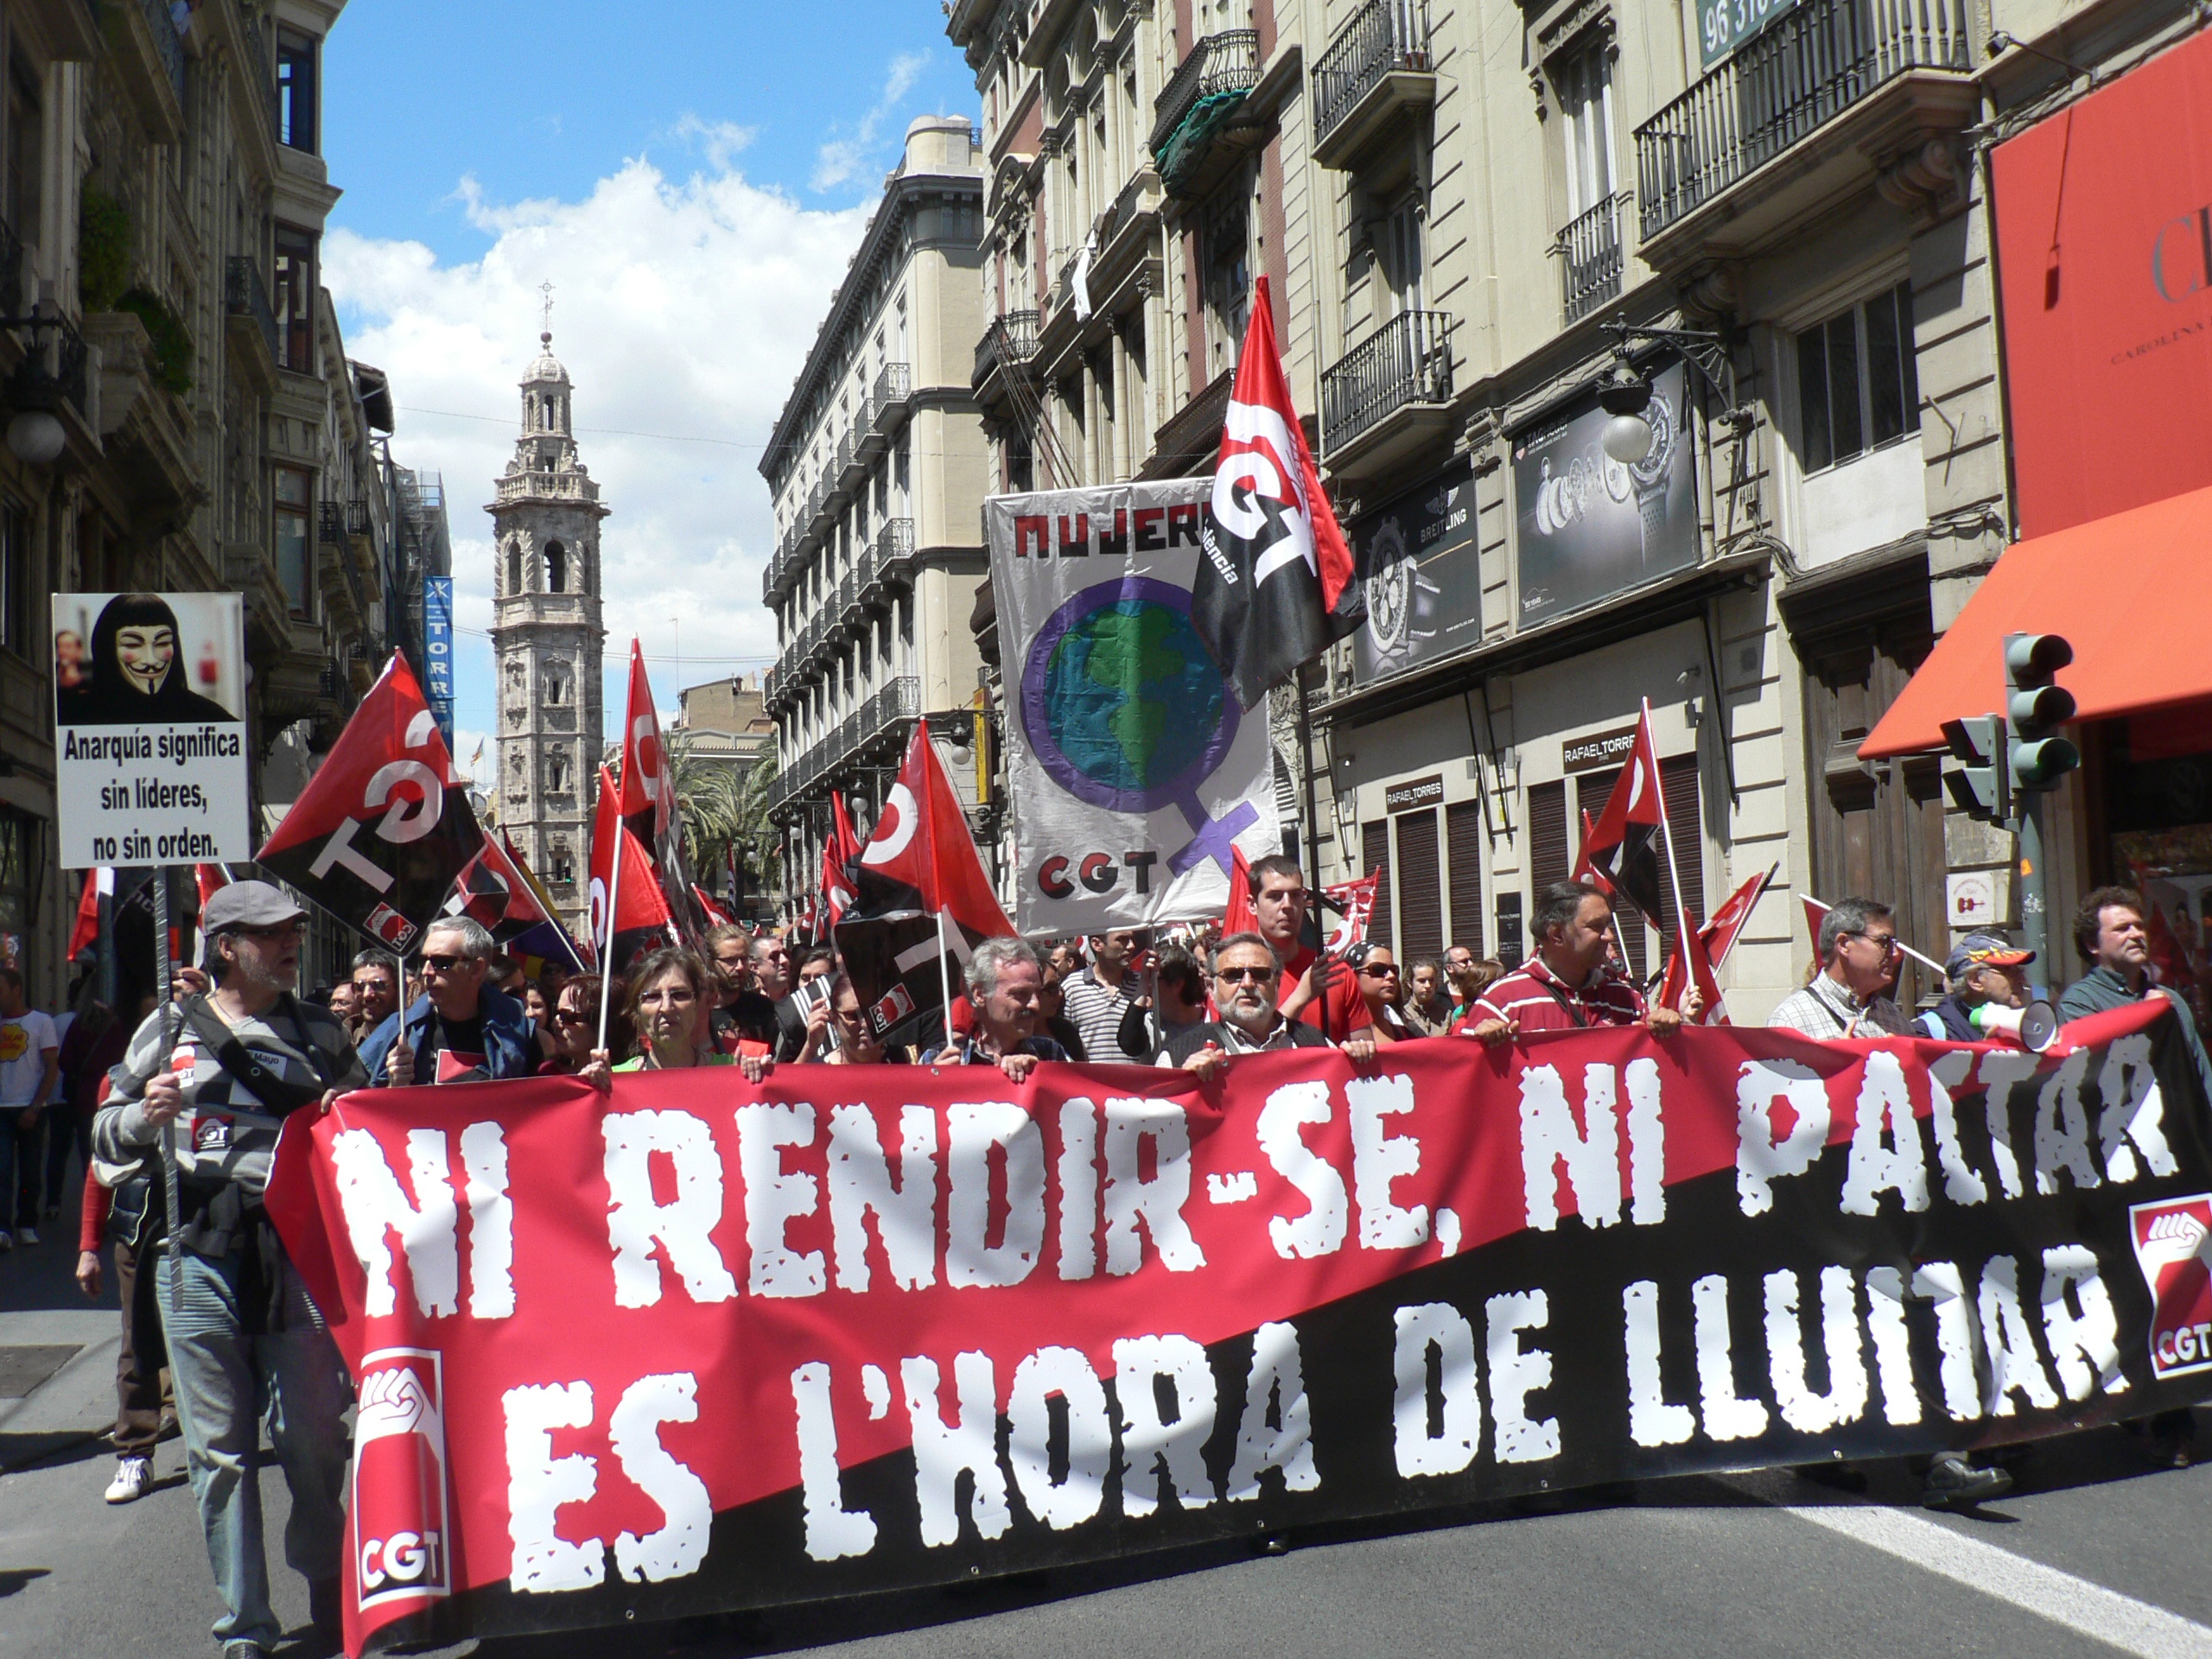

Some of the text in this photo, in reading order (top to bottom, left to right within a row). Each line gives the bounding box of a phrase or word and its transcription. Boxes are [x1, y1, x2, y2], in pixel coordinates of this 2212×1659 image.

[1706, 0, 1727, 52] 96
[1014, 501, 1210, 558] MUJER
[1420, 507, 1467, 543] BREITLING
[64, 726, 240, 767] Anarquía significa
[101, 777, 207, 814] sin líderes,
[93, 826, 219, 861] no sin orden.
[1038, 850, 1157, 900] CGT
[872, 1006, 887, 1034] CGT
[254, 1052, 280, 1065] Mayo
[330, 1120, 517, 1319] NI
[1517, 1057, 1667, 1232] NI
[2157, 1322, 2212, 1365] CGT
[501, 1243, 2132, 1594] ES L'HORA DE LLUITAR
[361, 1529, 439, 1589] CGT
